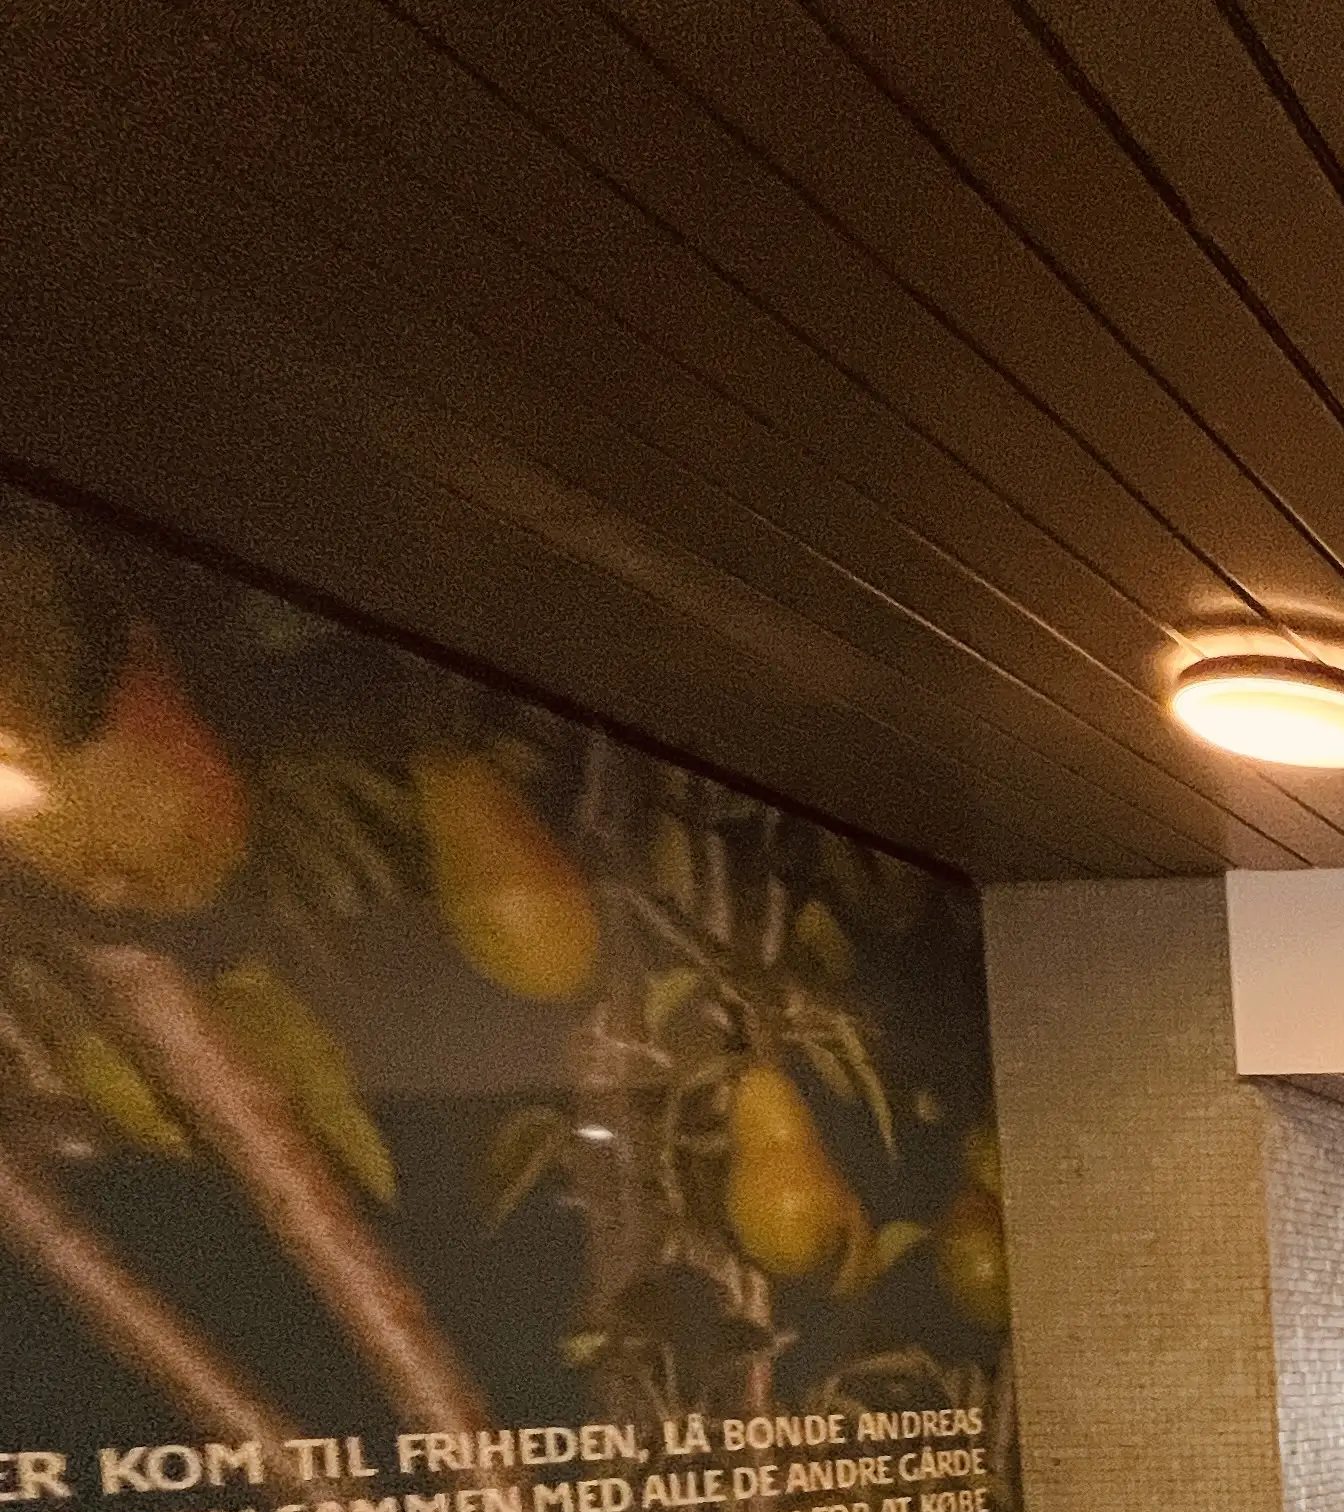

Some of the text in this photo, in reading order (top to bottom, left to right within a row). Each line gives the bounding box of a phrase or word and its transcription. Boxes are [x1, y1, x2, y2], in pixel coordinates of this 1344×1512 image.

[100, 1441, 263, 1494] KOM
[285, 1436, 378, 1480] TIL
[397, 1424, 649, 1474] FRIHEDEN,
[663, 1413, 710, 1455] LÅ
[723, 1414, 845, 1450] BONDE
[858, 1407, 983, 1441] ANDREAS
[642, 1470, 727, 1508] ALLE
[733, 1465, 780, 1500] DE
[786, 1456, 893, 1494] ANDRE
[900, 1446, 988, 1482] GÅRDE
